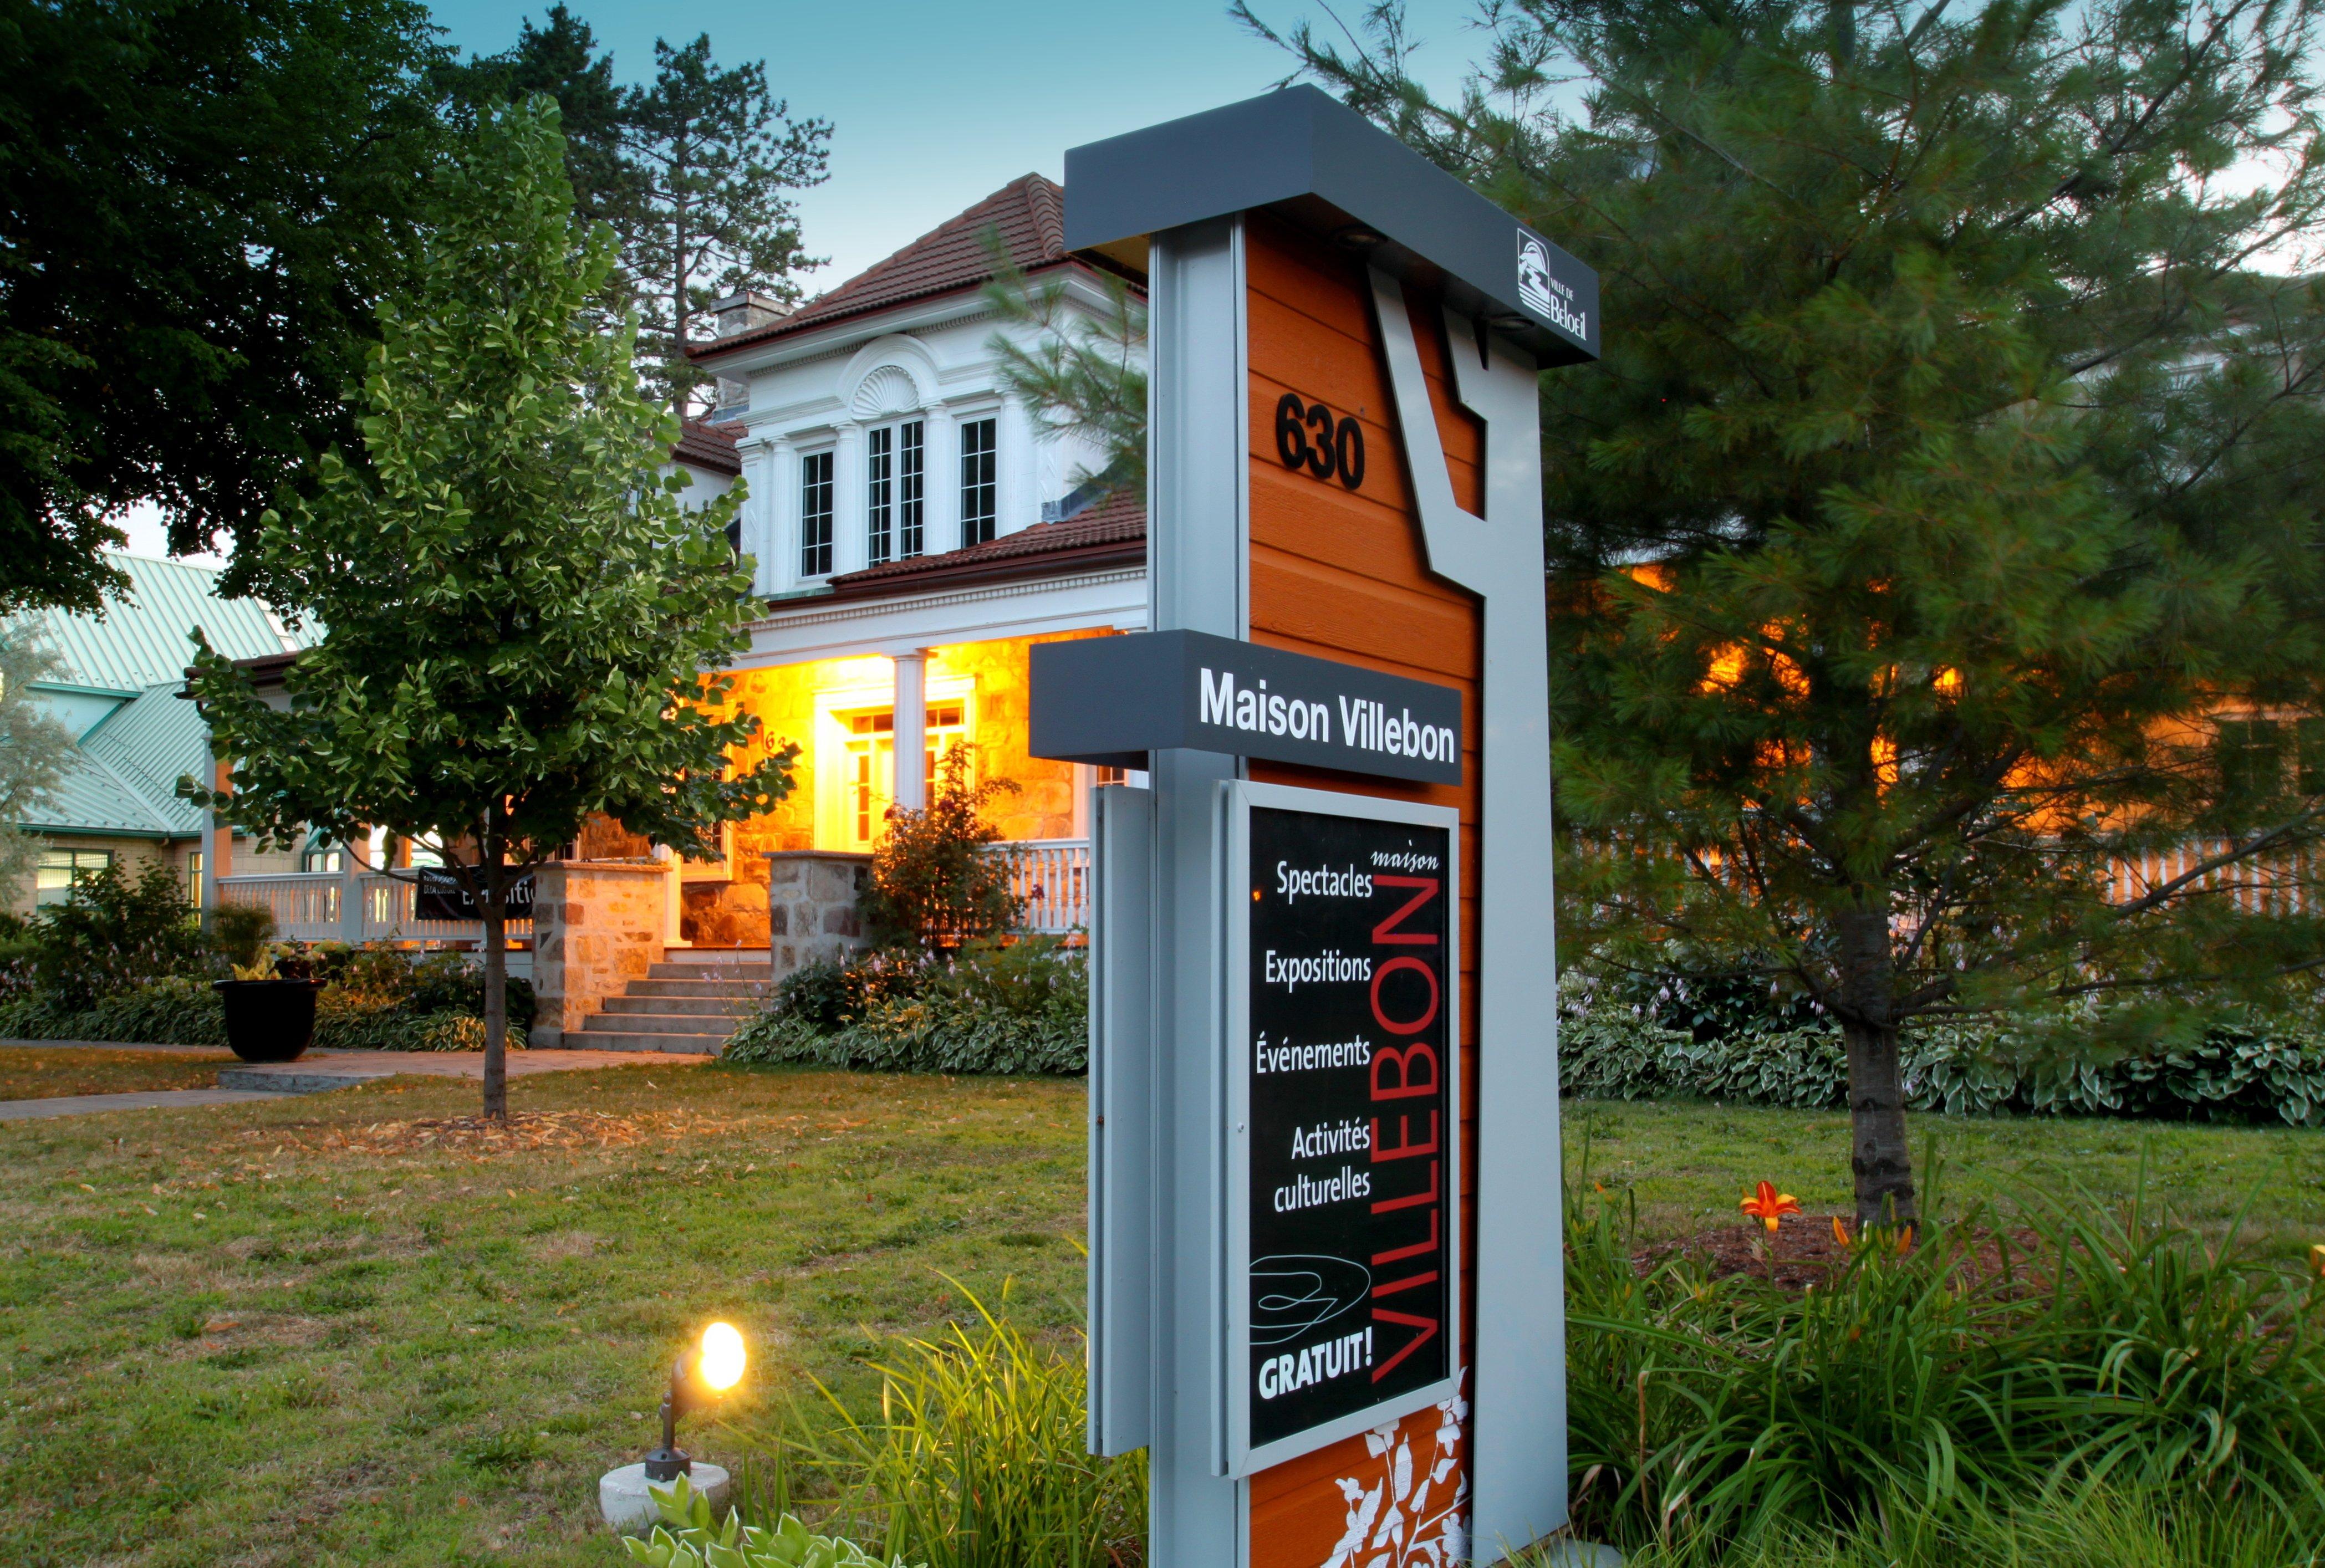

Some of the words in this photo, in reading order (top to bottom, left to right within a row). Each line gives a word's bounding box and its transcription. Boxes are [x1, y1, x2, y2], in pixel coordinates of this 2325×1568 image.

[1551, 278, 1564, 296] VILLE
[1566, 288, 1574, 302] DE
[1276, 393, 1365, 490] 630
[1200, 667, 1329, 743] Maison
[1339, 695, 1454, 763] Villebon
[766, 731, 786, 750] 63
[1370, 839, 1439, 872] maison
[1277, 860, 1373, 905] Spectacles
[1266, 949, 1371, 993] Expositions
[1256, 1030, 1370, 1074] Événements
[1291, 1116, 1370, 1160] Activités
[1370, 874, 1439, 1385] VILLEBON
[1274, 1165, 1370, 1213] culturelles
[1259, 1326, 1373, 1400] GRATUIT!
